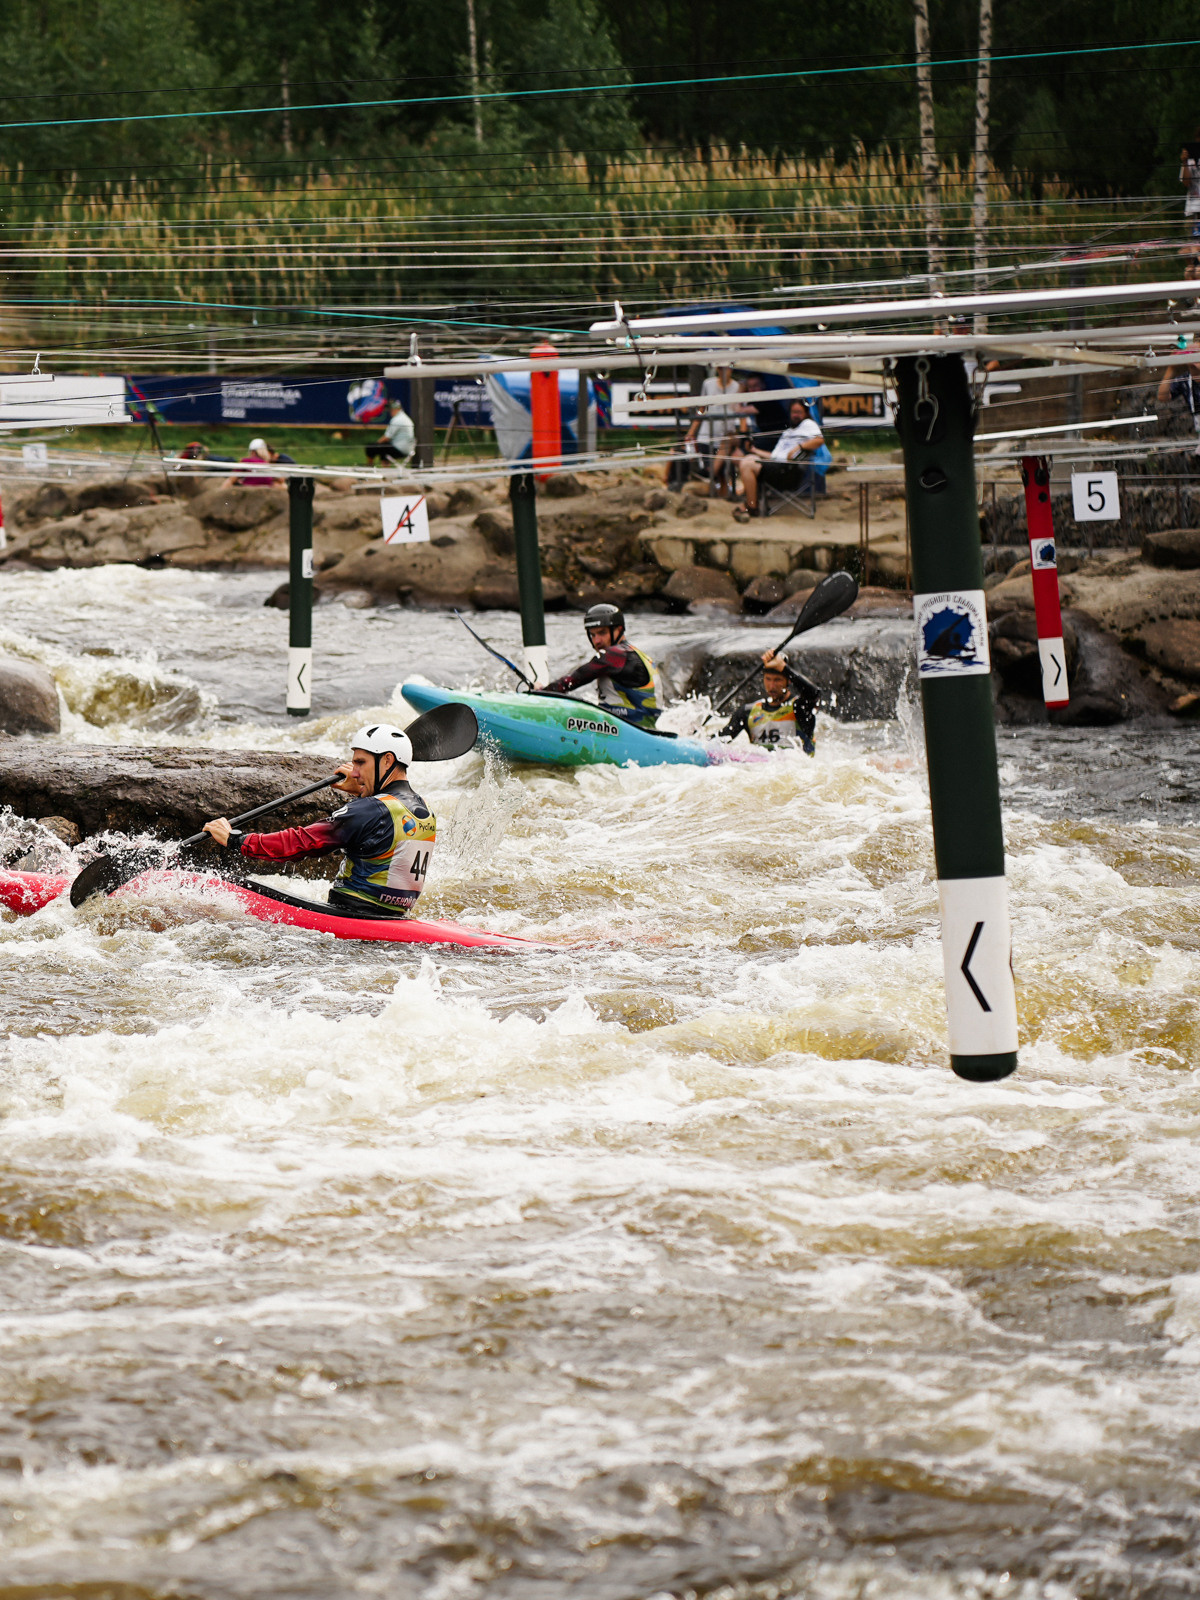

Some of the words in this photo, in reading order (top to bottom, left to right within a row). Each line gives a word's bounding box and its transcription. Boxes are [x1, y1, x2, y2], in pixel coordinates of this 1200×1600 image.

[1087, 479, 1106, 512] 5
[398, 504, 415, 534] 4
[567, 717, 619, 737] pyranha
[410, 850, 430, 882] 44
